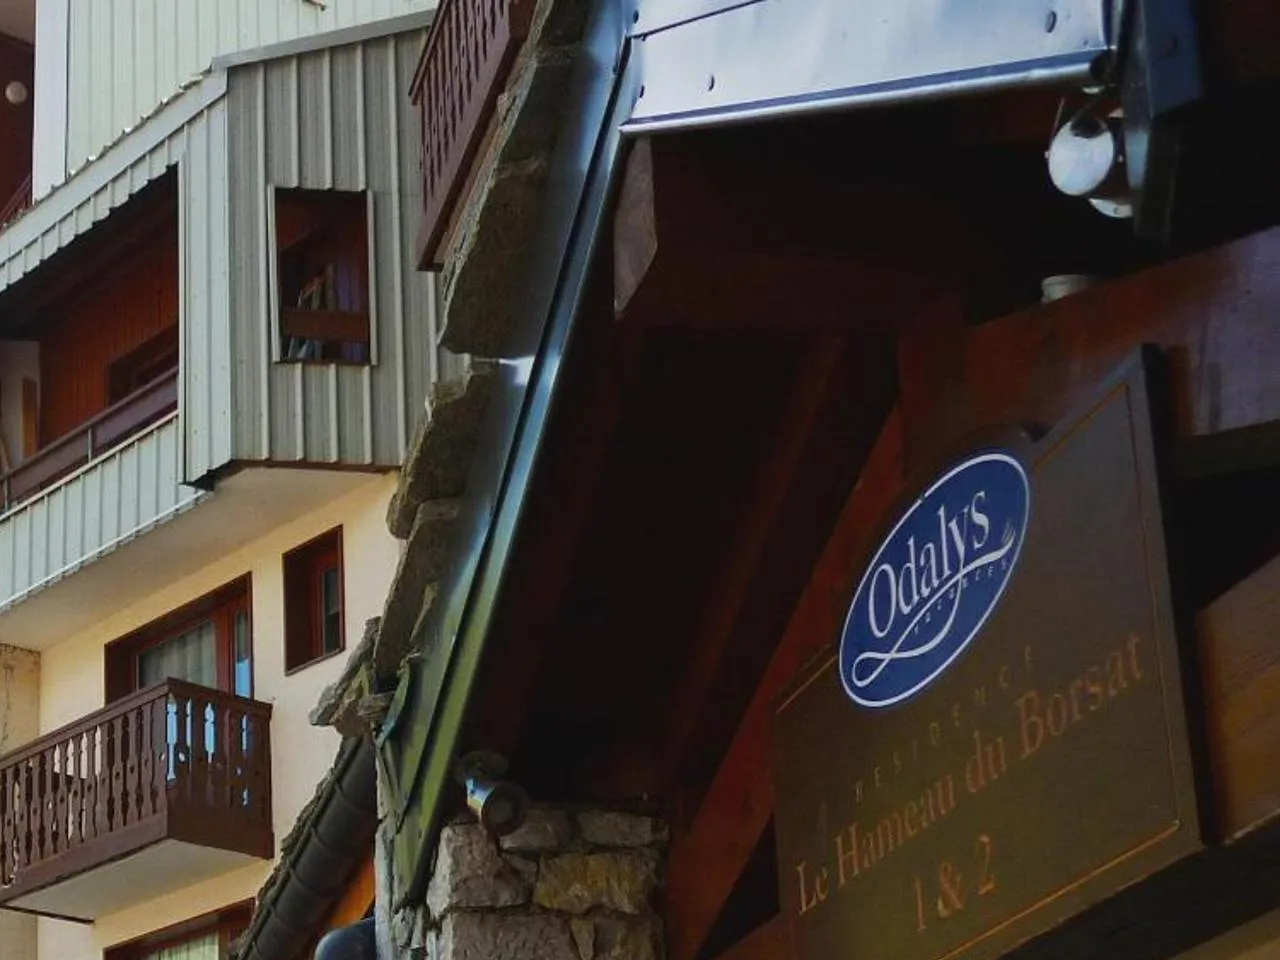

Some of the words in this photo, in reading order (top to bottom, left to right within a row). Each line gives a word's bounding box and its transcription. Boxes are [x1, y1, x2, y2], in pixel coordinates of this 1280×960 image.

[867, 489, 991, 639] Odalys
[796, 859, 829, 916] Le
[833, 771, 958, 889] Hameau
[964, 730, 1008, 794] du
[1014, 632, 1145, 760] Borsat
[936, 862, 965, 919] &
[976, 833, 999, 897] 2
